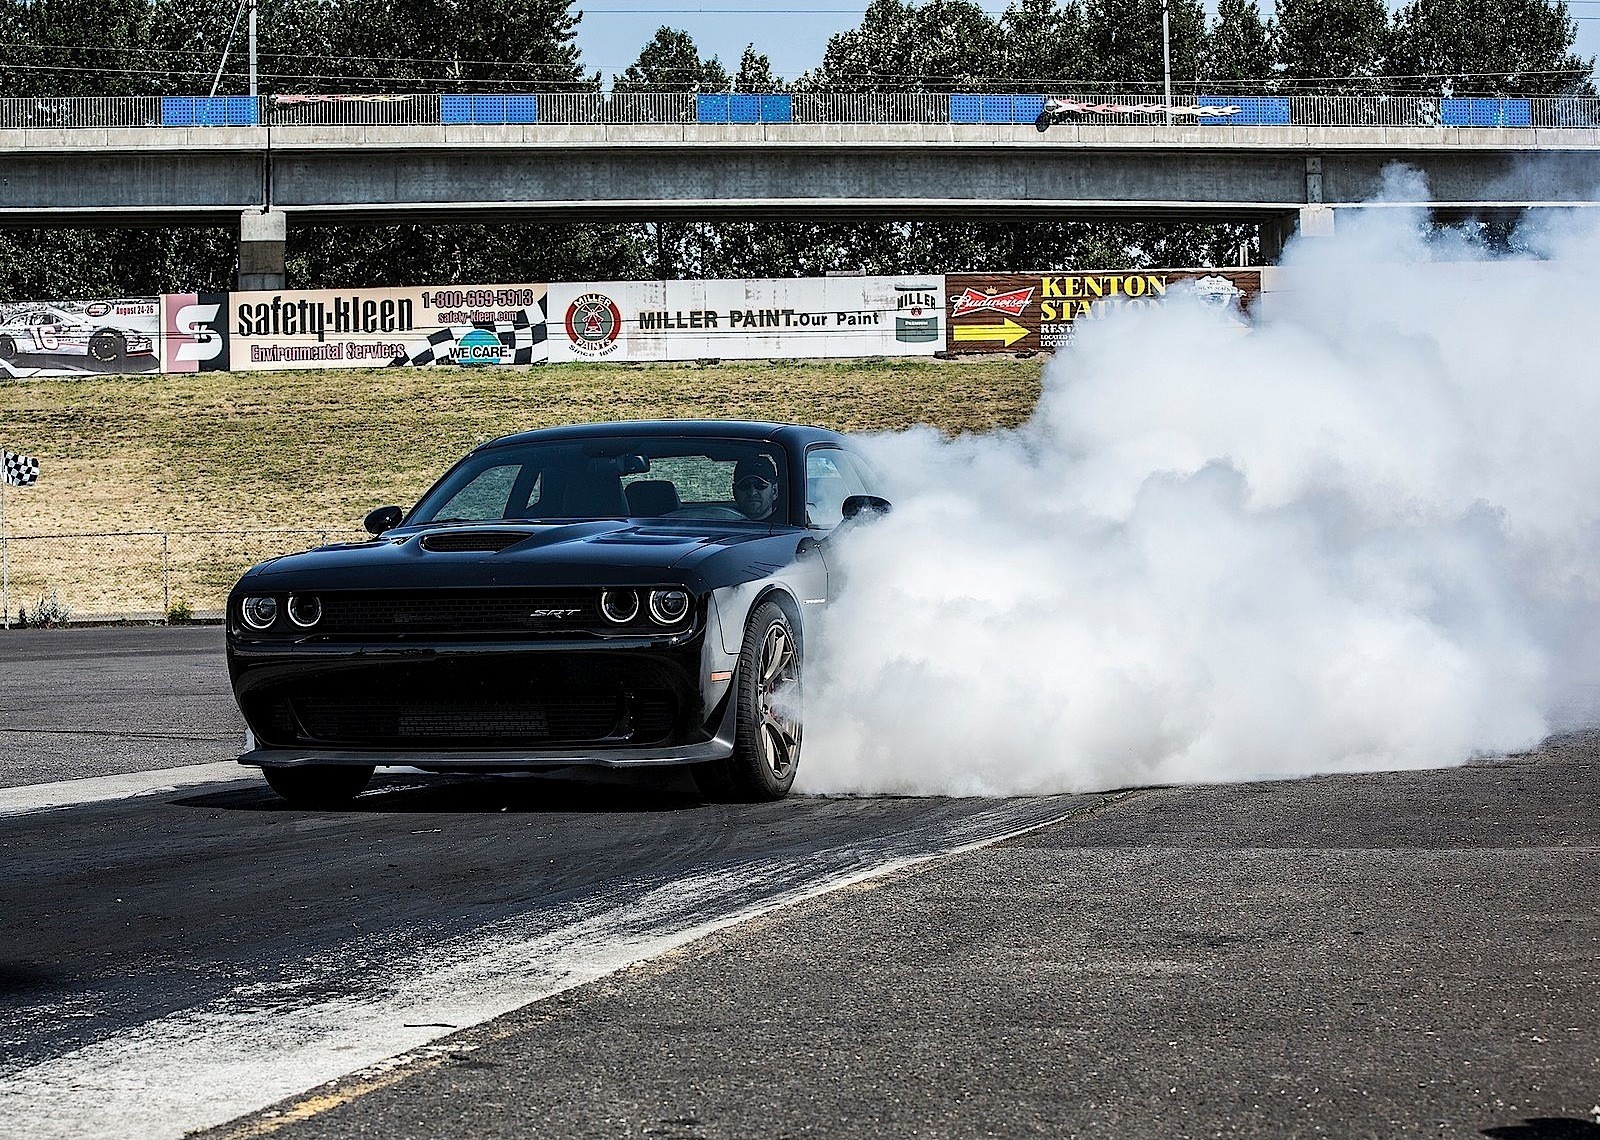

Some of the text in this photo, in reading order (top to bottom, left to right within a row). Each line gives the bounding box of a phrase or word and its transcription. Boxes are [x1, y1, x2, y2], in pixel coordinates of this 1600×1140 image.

[1040, 275, 1168, 298] KENTON
[422, 289, 534, 308] 1-800-669-5913
[573, 294, 612, 307] MILLER
[897, 292, 936, 310] MILLER
[950, 295, 1032, 309] Budweiser
[116, 306, 136, 315] August
[137, 305, 154, 315] 24-26
[438, 309, 518, 324] safety-kleen.com
[639, 310, 719, 329] MILLER
[799, 312, 828, 327] Our
[836, 311, 879, 326] Paint
[1040, 323, 1078, 334] REST
[575, 338, 611, 351] PAINTS
[251, 342, 406, 362] Environmental Services
[449, 346, 512, 359] WE CARE.
[530, 609, 582, 619] SRT
